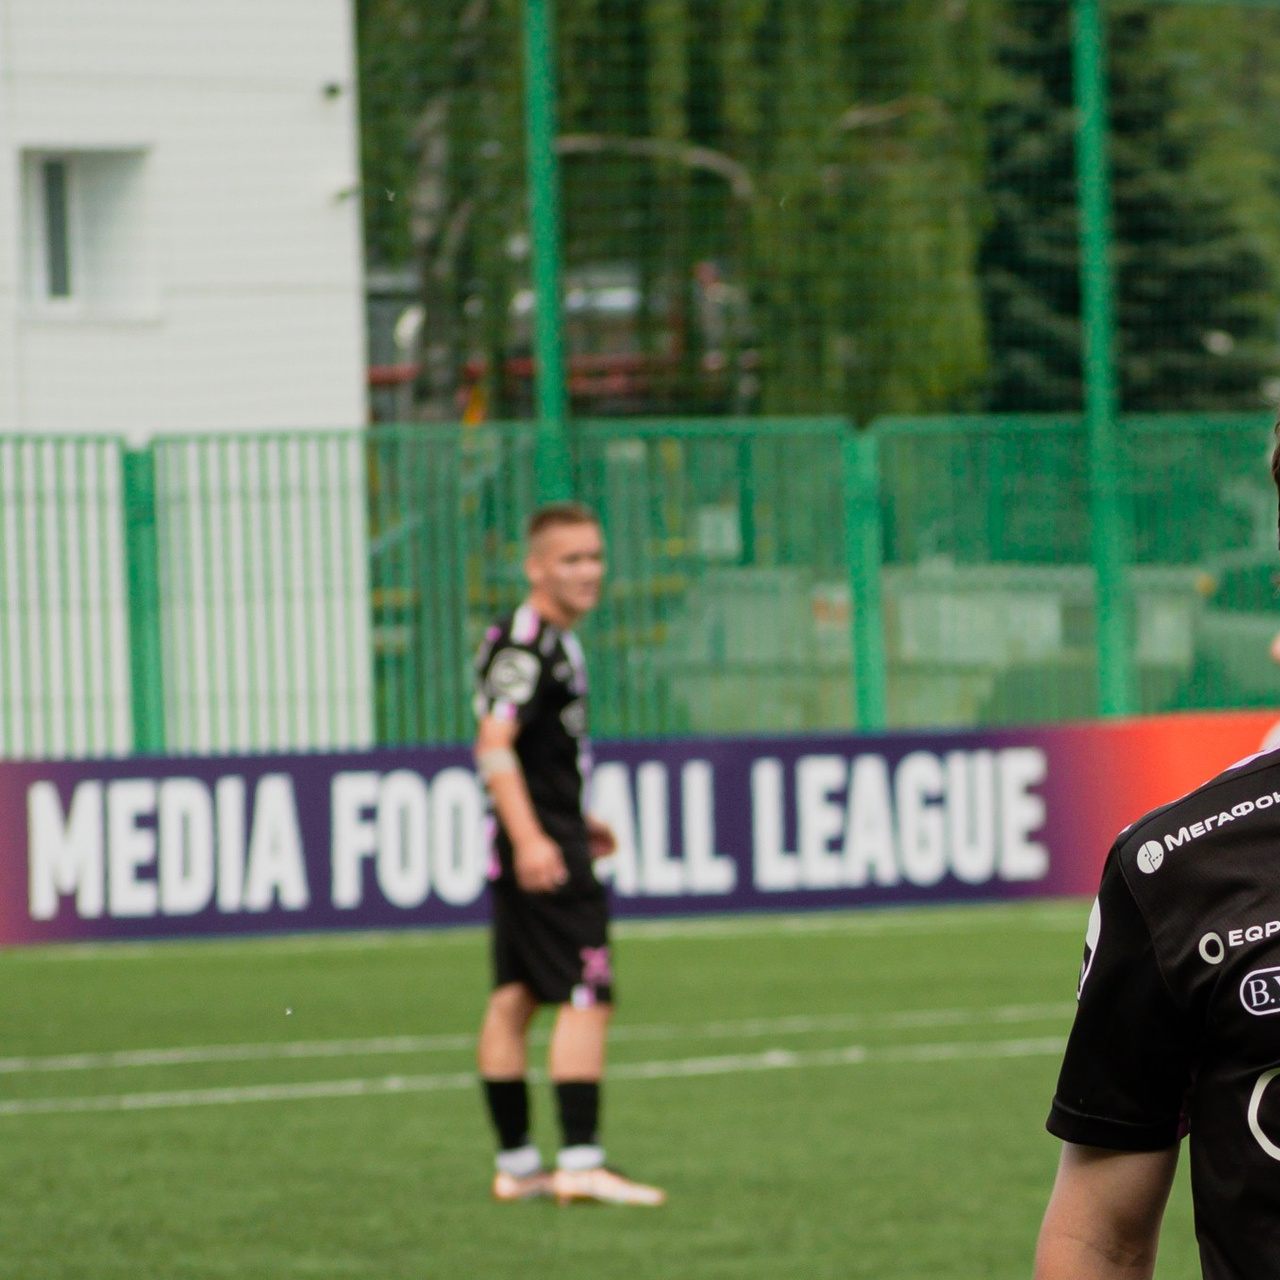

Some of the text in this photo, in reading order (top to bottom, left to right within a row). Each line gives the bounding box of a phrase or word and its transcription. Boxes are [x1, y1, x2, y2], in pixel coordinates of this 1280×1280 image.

[27, 747, 1049, 921] MEDIA FOOALL LEAGUE
